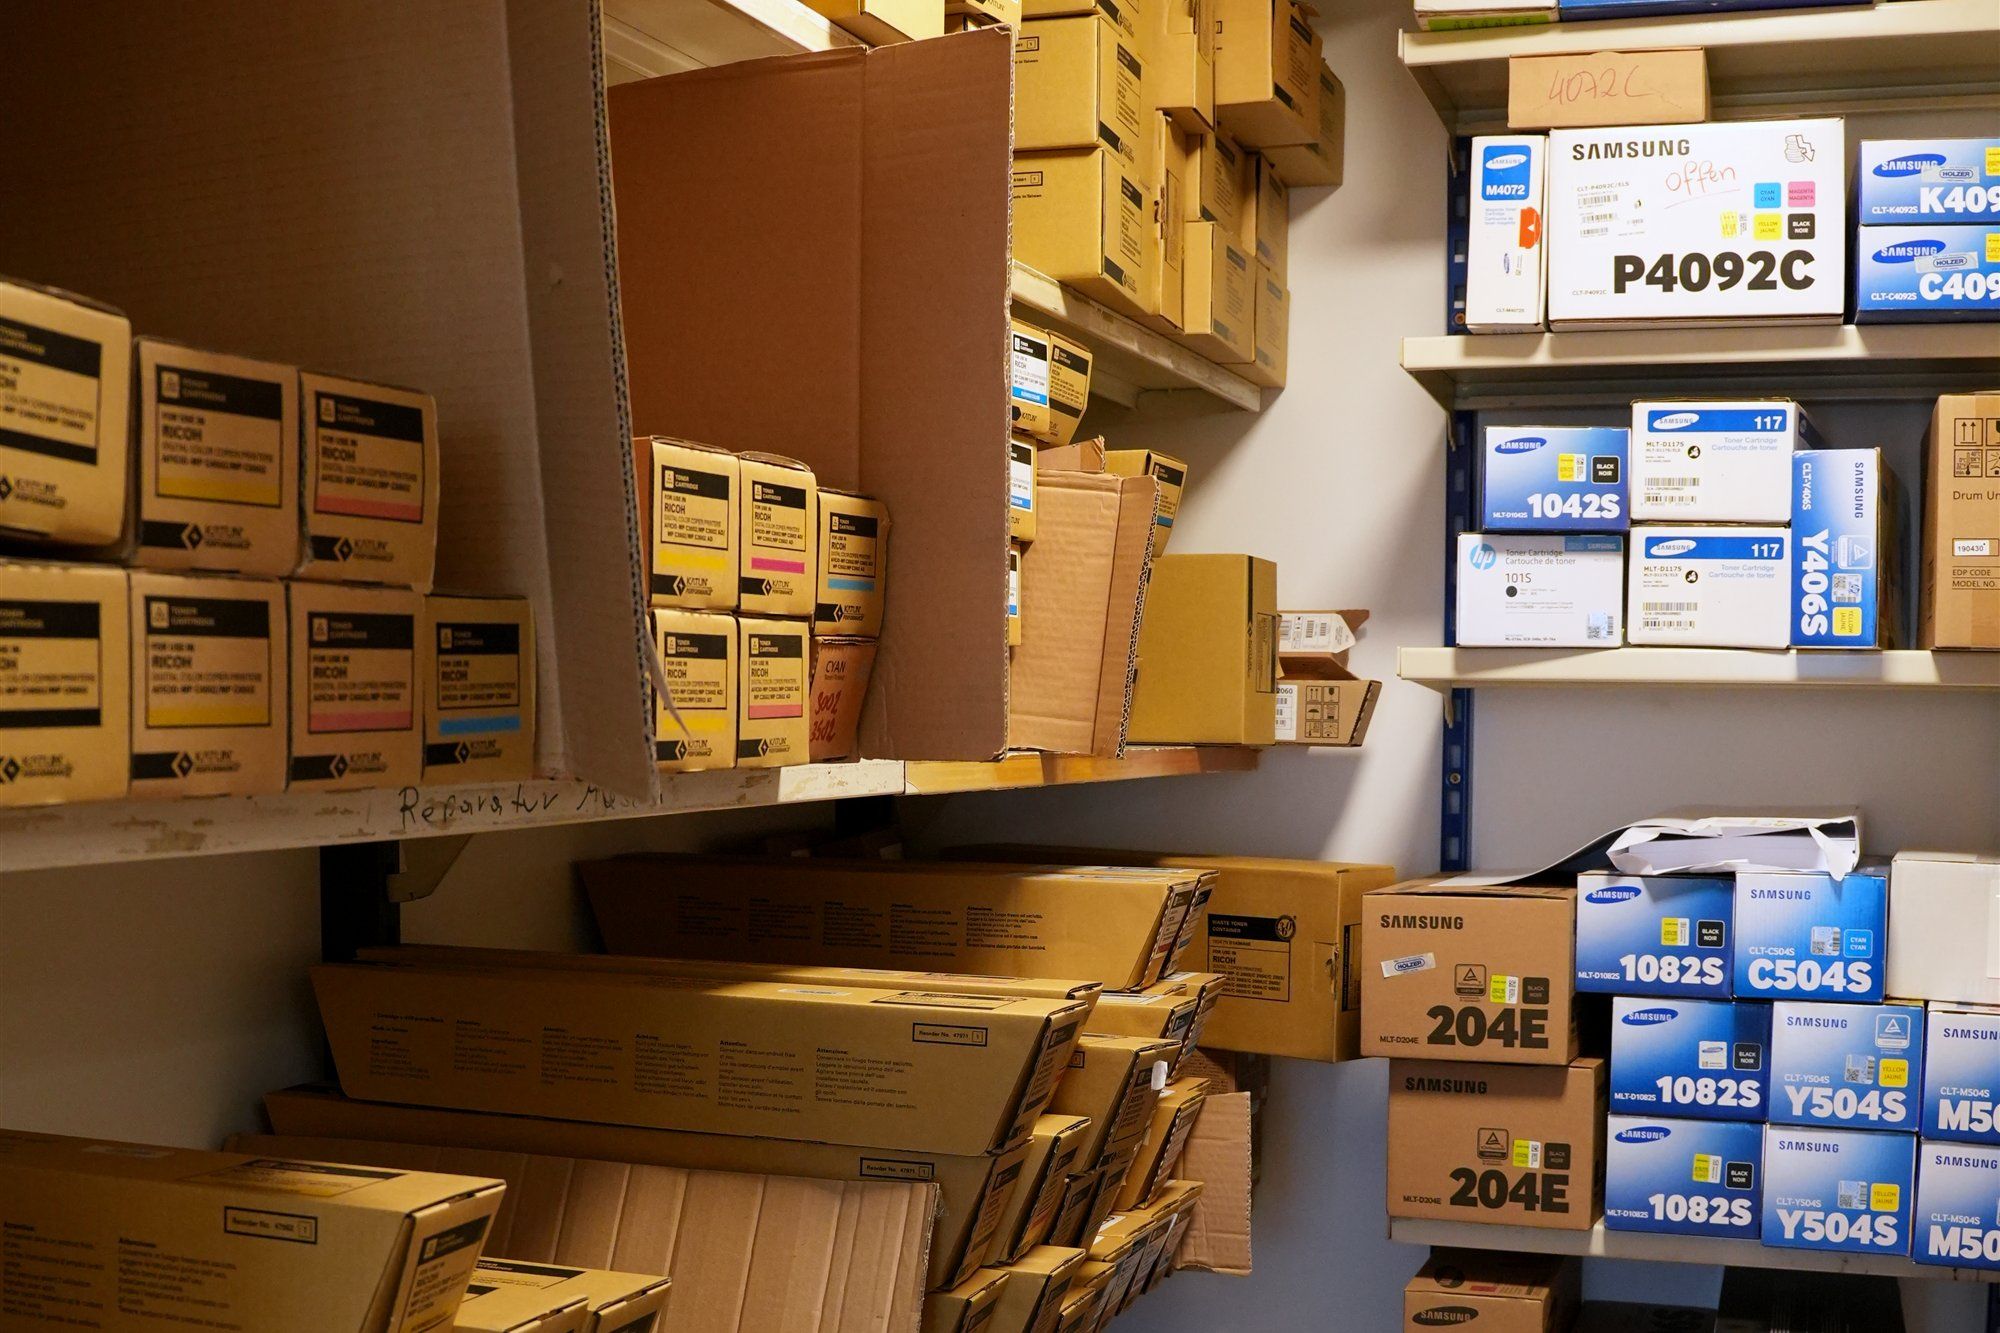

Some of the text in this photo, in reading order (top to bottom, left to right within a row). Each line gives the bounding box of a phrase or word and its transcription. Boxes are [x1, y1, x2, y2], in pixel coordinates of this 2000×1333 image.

[1572, 140, 1690, 160] SAMSUNG
[1881, 160, 1938, 170] SAMSUNG
[1486, 184, 1525, 196] M4072
[1872, 206, 1918, 214] CLT-K4092S
[1881, 247, 1937, 256] SAMSUNG
[1936, 258, 1964, 266] HOLZER
[1614, 249, 1815, 294] P4092C
[1871, 292, 1917, 301] CLT-C4092S
[1754, 416, 1782, 430] 117
[1802, 463, 1811, 510] CLT-Y406S
[1854, 462, 1864, 519] SAMSUNG
[1953, 491, 1982, 500] Drum
[665, 503, 685, 514] RICOH
[1527, 493, 1620, 519] 1042S
[755, 512, 771, 521] RICOH
[832, 542, 846, 550] RICOH
[1752, 544, 1780, 557] 117
[1472, 543, 1496, 570] hp
[686, 577, 708, 586] KATUN
[1505, 573, 1532, 583] 101S
[1801, 529, 1829, 636] Y406S
[826, 661, 846, 672] CYAN
[313, 666, 347, 679] RICOH
[668, 669, 686, 678] RICOH
[752, 668, 768, 677] RICOH
[1592, 891, 1635, 899] SAMSUNG
[1751, 889, 1811, 900] SAMSUNG
[1381, 915, 1464, 930] SAMSUNG
[1750, 947, 1795, 956] CLT-C504S
[1213, 956, 1236, 964] RICOH
[1397, 960, 1422, 969] HOLZER
[1620, 954, 1724, 985] 1082S
[1578, 972, 1620, 980] MLT-D1082S
[1748, 958, 1872, 993] C504S
[1629, 1013, 1672, 1022] SAMSUNG
[1787, 1017, 1848, 1028] SAMSUNG
[1427, 1005, 1549, 1049] 204E
[1380, 1036, 1419, 1044] MLT-D204E
[1943, 1028, 2000, 1041] SAMSUN
[1784, 1074, 1830, 1083] CLT-Y504S
[1406, 1077, 1487, 1094] SAMSUNG
[1614, 1093, 1656, 1101] MLT-D1082S
[1656, 1076, 1760, 1108] 1082S
[1940, 1087, 1990, 1098] CLT-M504S
[1784, 1086, 1907, 1122] Y504S
[1621, 1131, 1665, 1139] SAMSUNG
[1779, 1141, 1839, 1153] SAMSUNG
[1935, 1155, 1998, 1170] SAMSUNG
[1450, 1168, 1569, 1214] 204E
[1403, 1195, 1441, 1205] MLT-D204E
[1776, 1198, 1821, 1207] CLT-Y504S
[1607, 1209, 1648, 1218] MLT-D1082S
[1649, 1194, 1752, 1226] 1082S
[1931, 1213, 1980, 1225] CLT-M504S
[1776, 1209, 1898, 1246] Y504S
[1421, 1311, 1470, 1321] SAMSUNG
